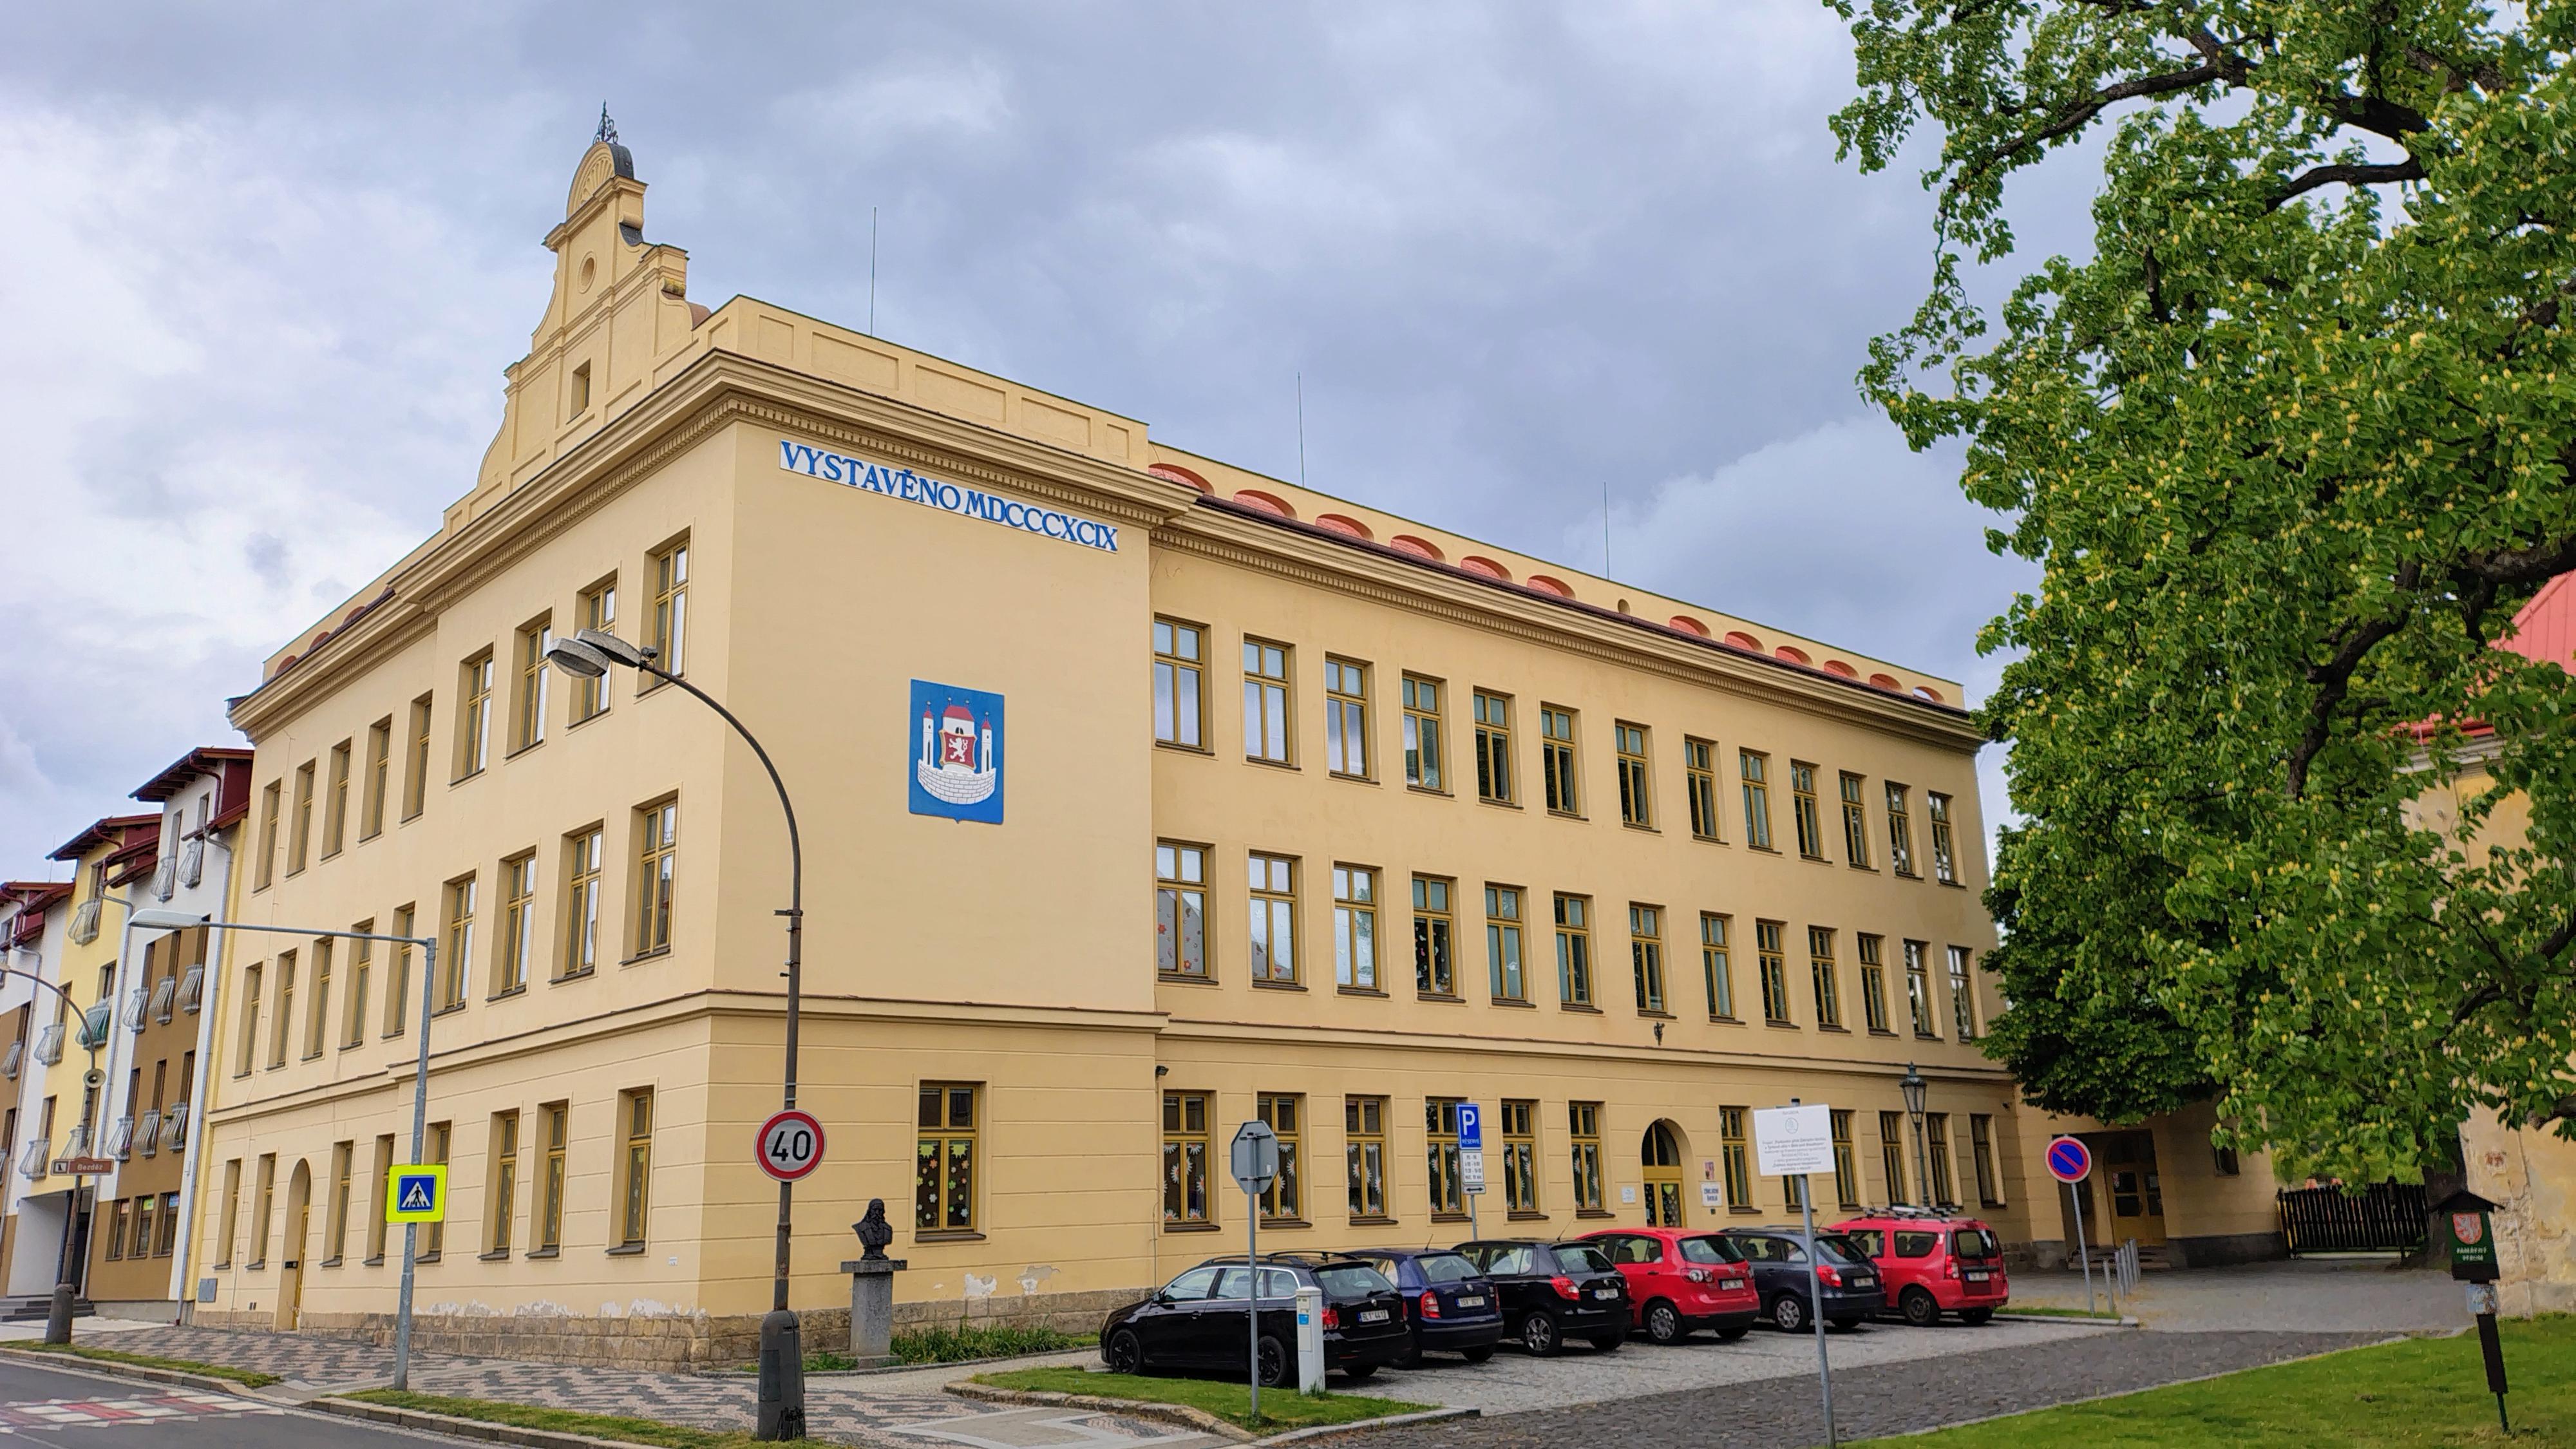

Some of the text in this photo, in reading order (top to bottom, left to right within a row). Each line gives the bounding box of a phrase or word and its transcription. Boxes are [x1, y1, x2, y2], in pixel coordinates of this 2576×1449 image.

[781, 440, 1118, 552] VYSTAVĚNO MDCCCXCIX
[1462, 1110, 1475, 1136] P
[771, 1130, 811, 1162] 40
